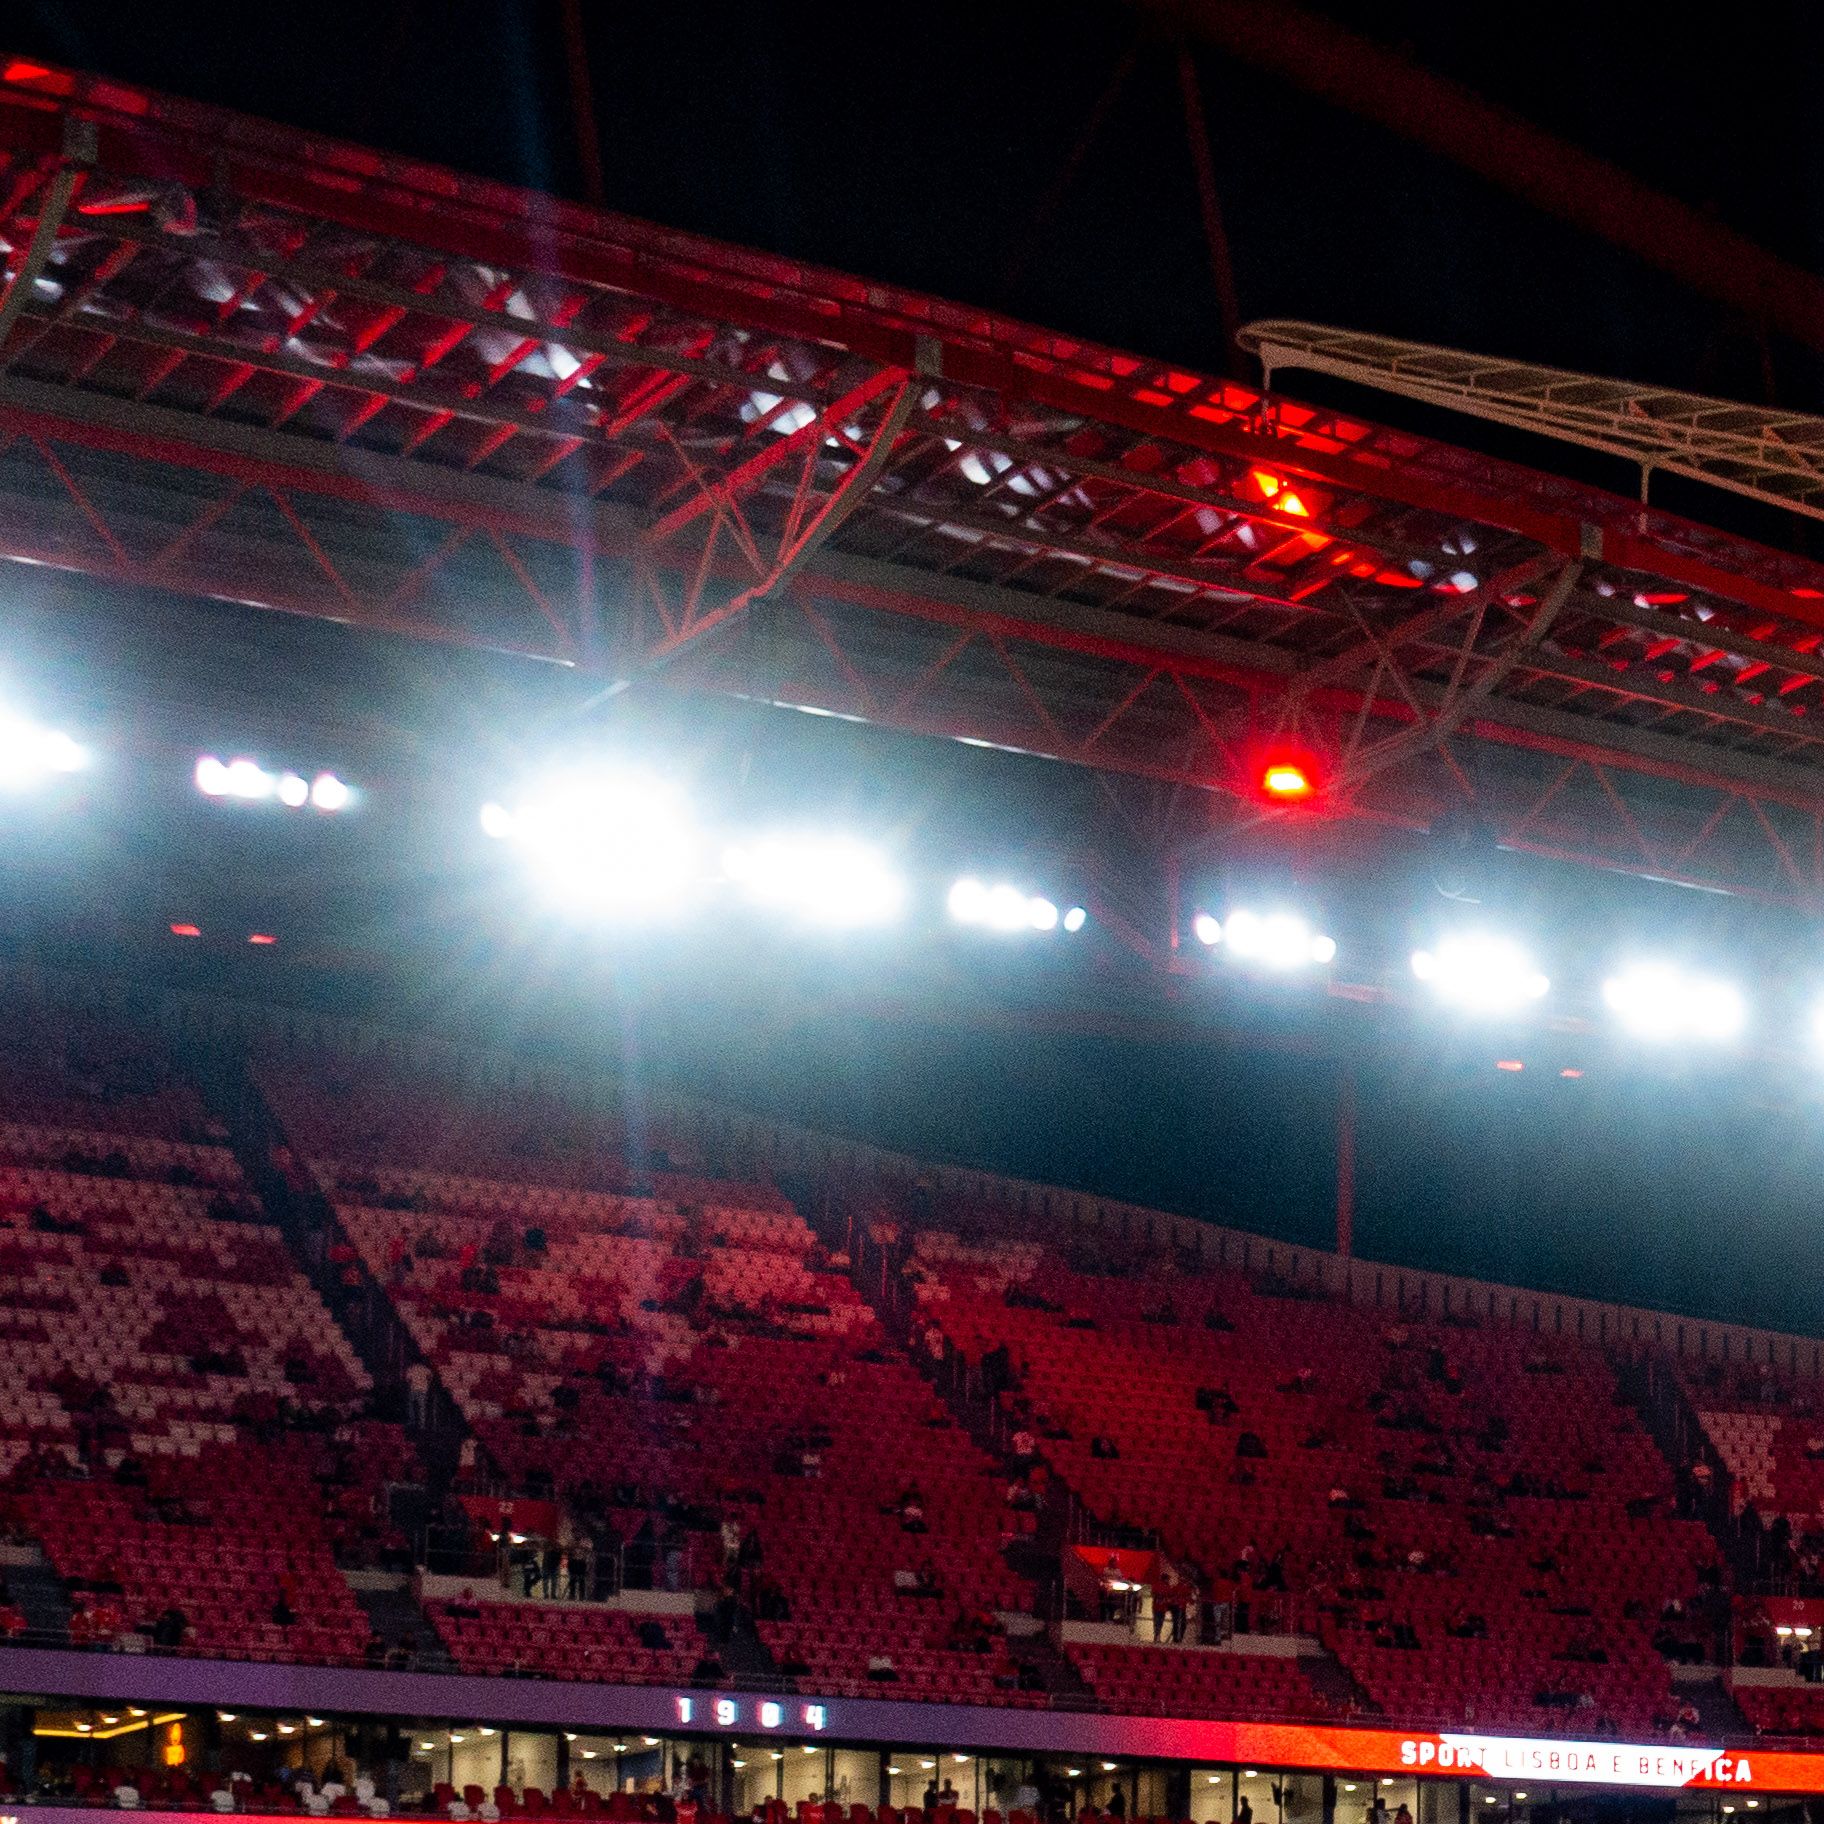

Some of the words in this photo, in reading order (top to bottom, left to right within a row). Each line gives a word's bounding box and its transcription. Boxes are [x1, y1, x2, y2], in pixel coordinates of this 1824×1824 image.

[678, 1697, 828, 1731] 1904
[1504, 1750, 1596, 1771] LISBOA
[1612, 1755, 1622, 1773] E
[1638, 1756, 1752, 1782] BENFICA
